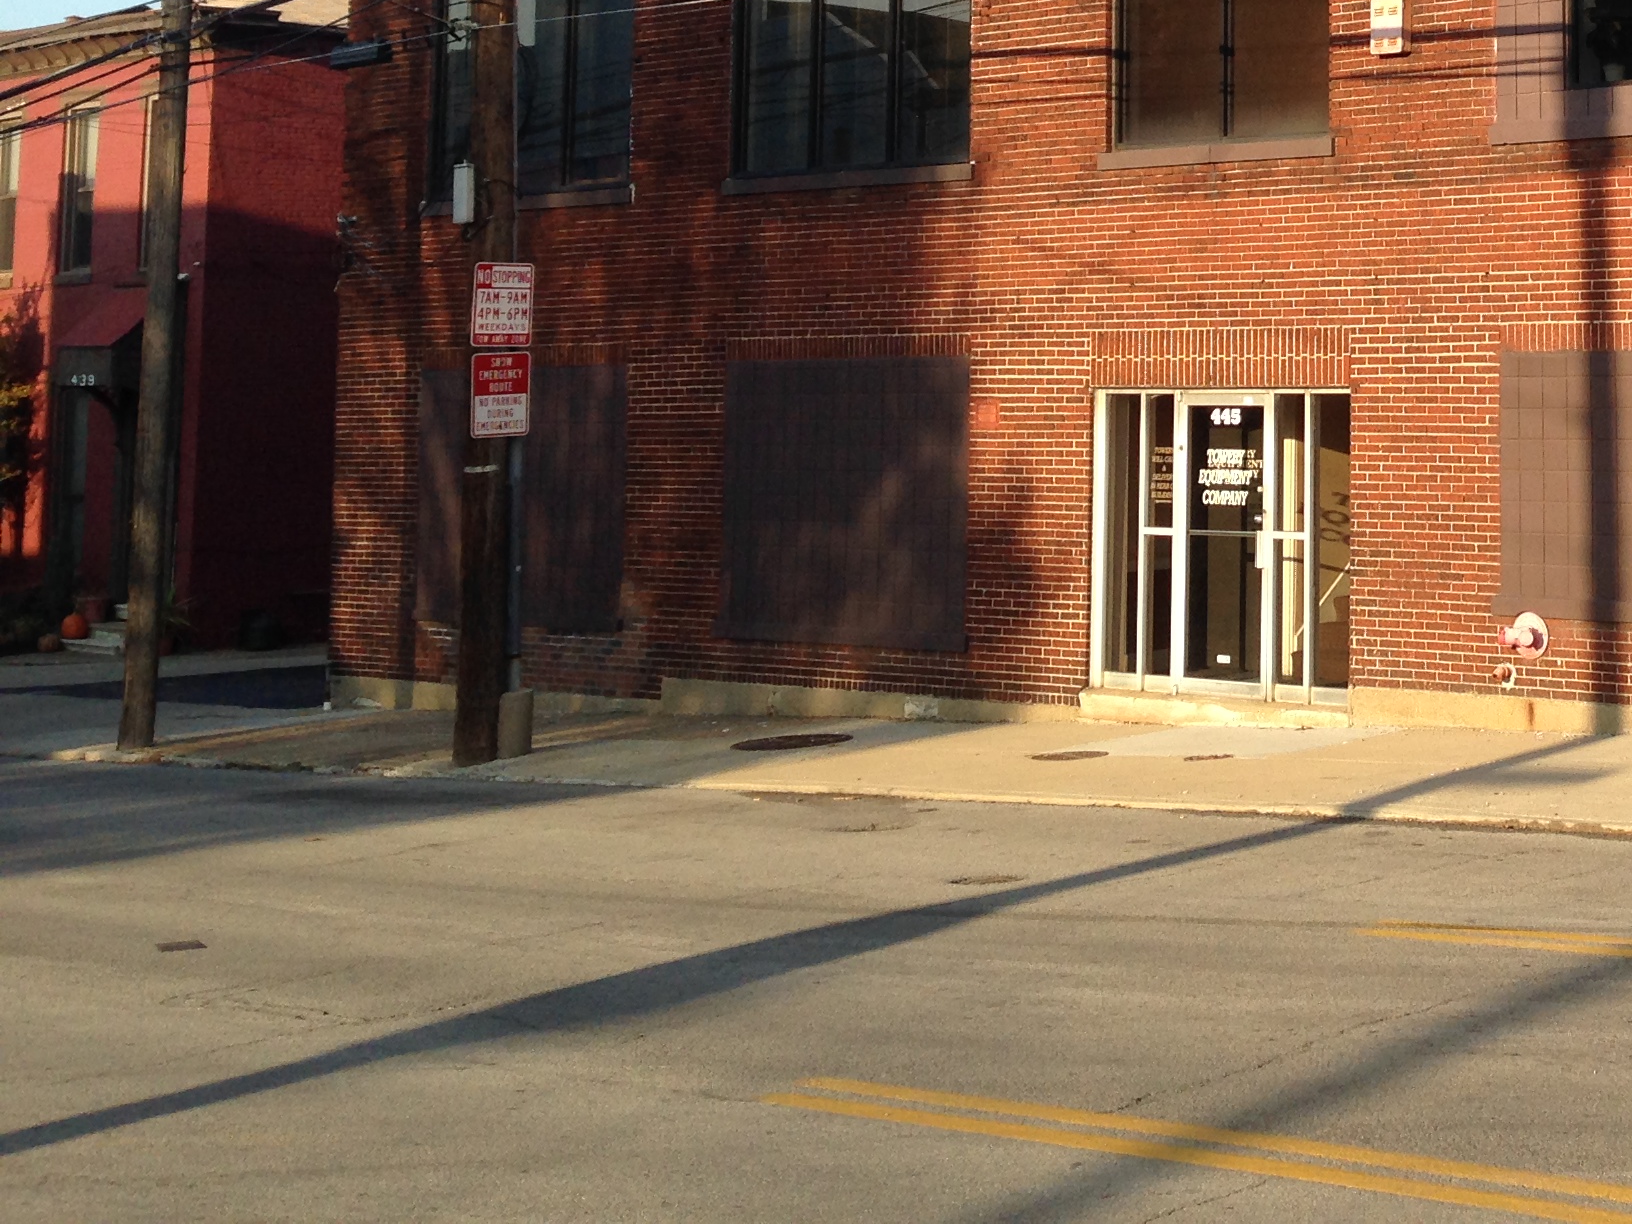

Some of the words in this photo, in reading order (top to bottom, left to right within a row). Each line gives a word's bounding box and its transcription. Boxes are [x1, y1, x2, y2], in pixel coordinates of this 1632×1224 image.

[477, 269, 491, 284] NO
[492, 270, 532, 284] STOPPING
[480, 290, 528, 305] 7AM-9AM
[477, 307, 529, 321] 4PM-6PM
[478, 322, 527, 332] WEEKDAYS
[476, 335, 489, 344] TOW
[491, 335, 508, 343] AWAY
[491, 357, 513, 368] SNOW
[70, 373, 95, 386] 439
[478, 368, 523, 381] EMERGENCY
[489, 381, 513, 393] ROUTE
[479, 397, 489, 407] NO
[491, 395, 523, 407] PARKING
[487, 408, 514, 419] DURING
[1210, 408, 1242, 425] 445
[476, 420, 525, 432] EMERGENCIES
[1198, 468, 1253, 487] EQUIPMENT
[1202, 489, 1249, 506] COMPANY
